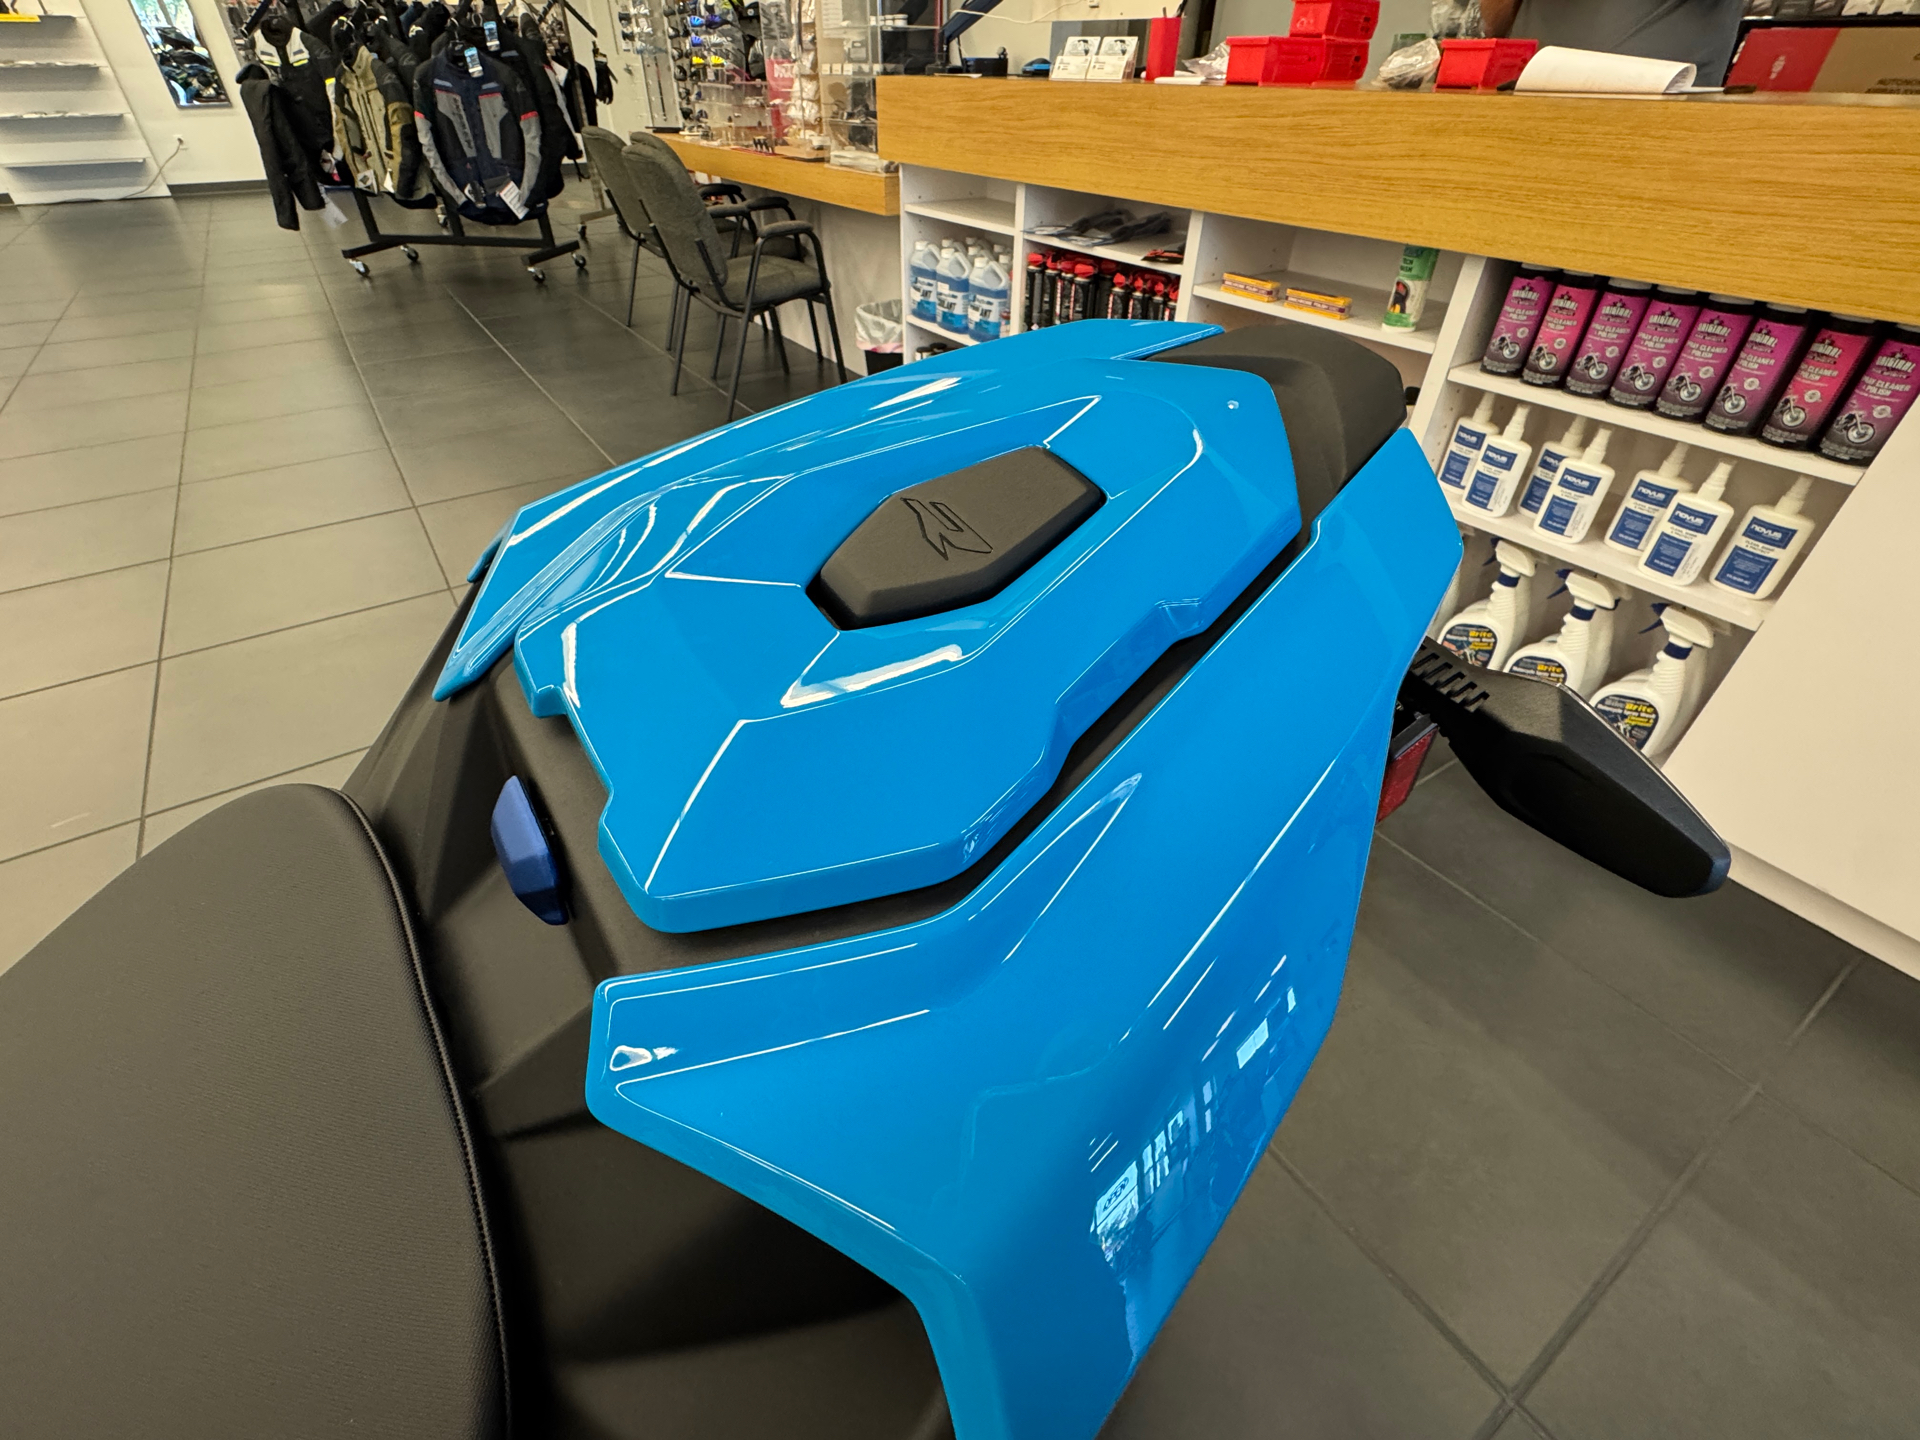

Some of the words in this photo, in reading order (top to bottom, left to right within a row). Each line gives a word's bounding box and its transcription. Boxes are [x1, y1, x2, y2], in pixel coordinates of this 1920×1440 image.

[1875, 356, 1916, 373] ORIGINAL
[1866, 385, 1892, 397] POLISH
[1876, 379, 1912, 392] CLEANER
